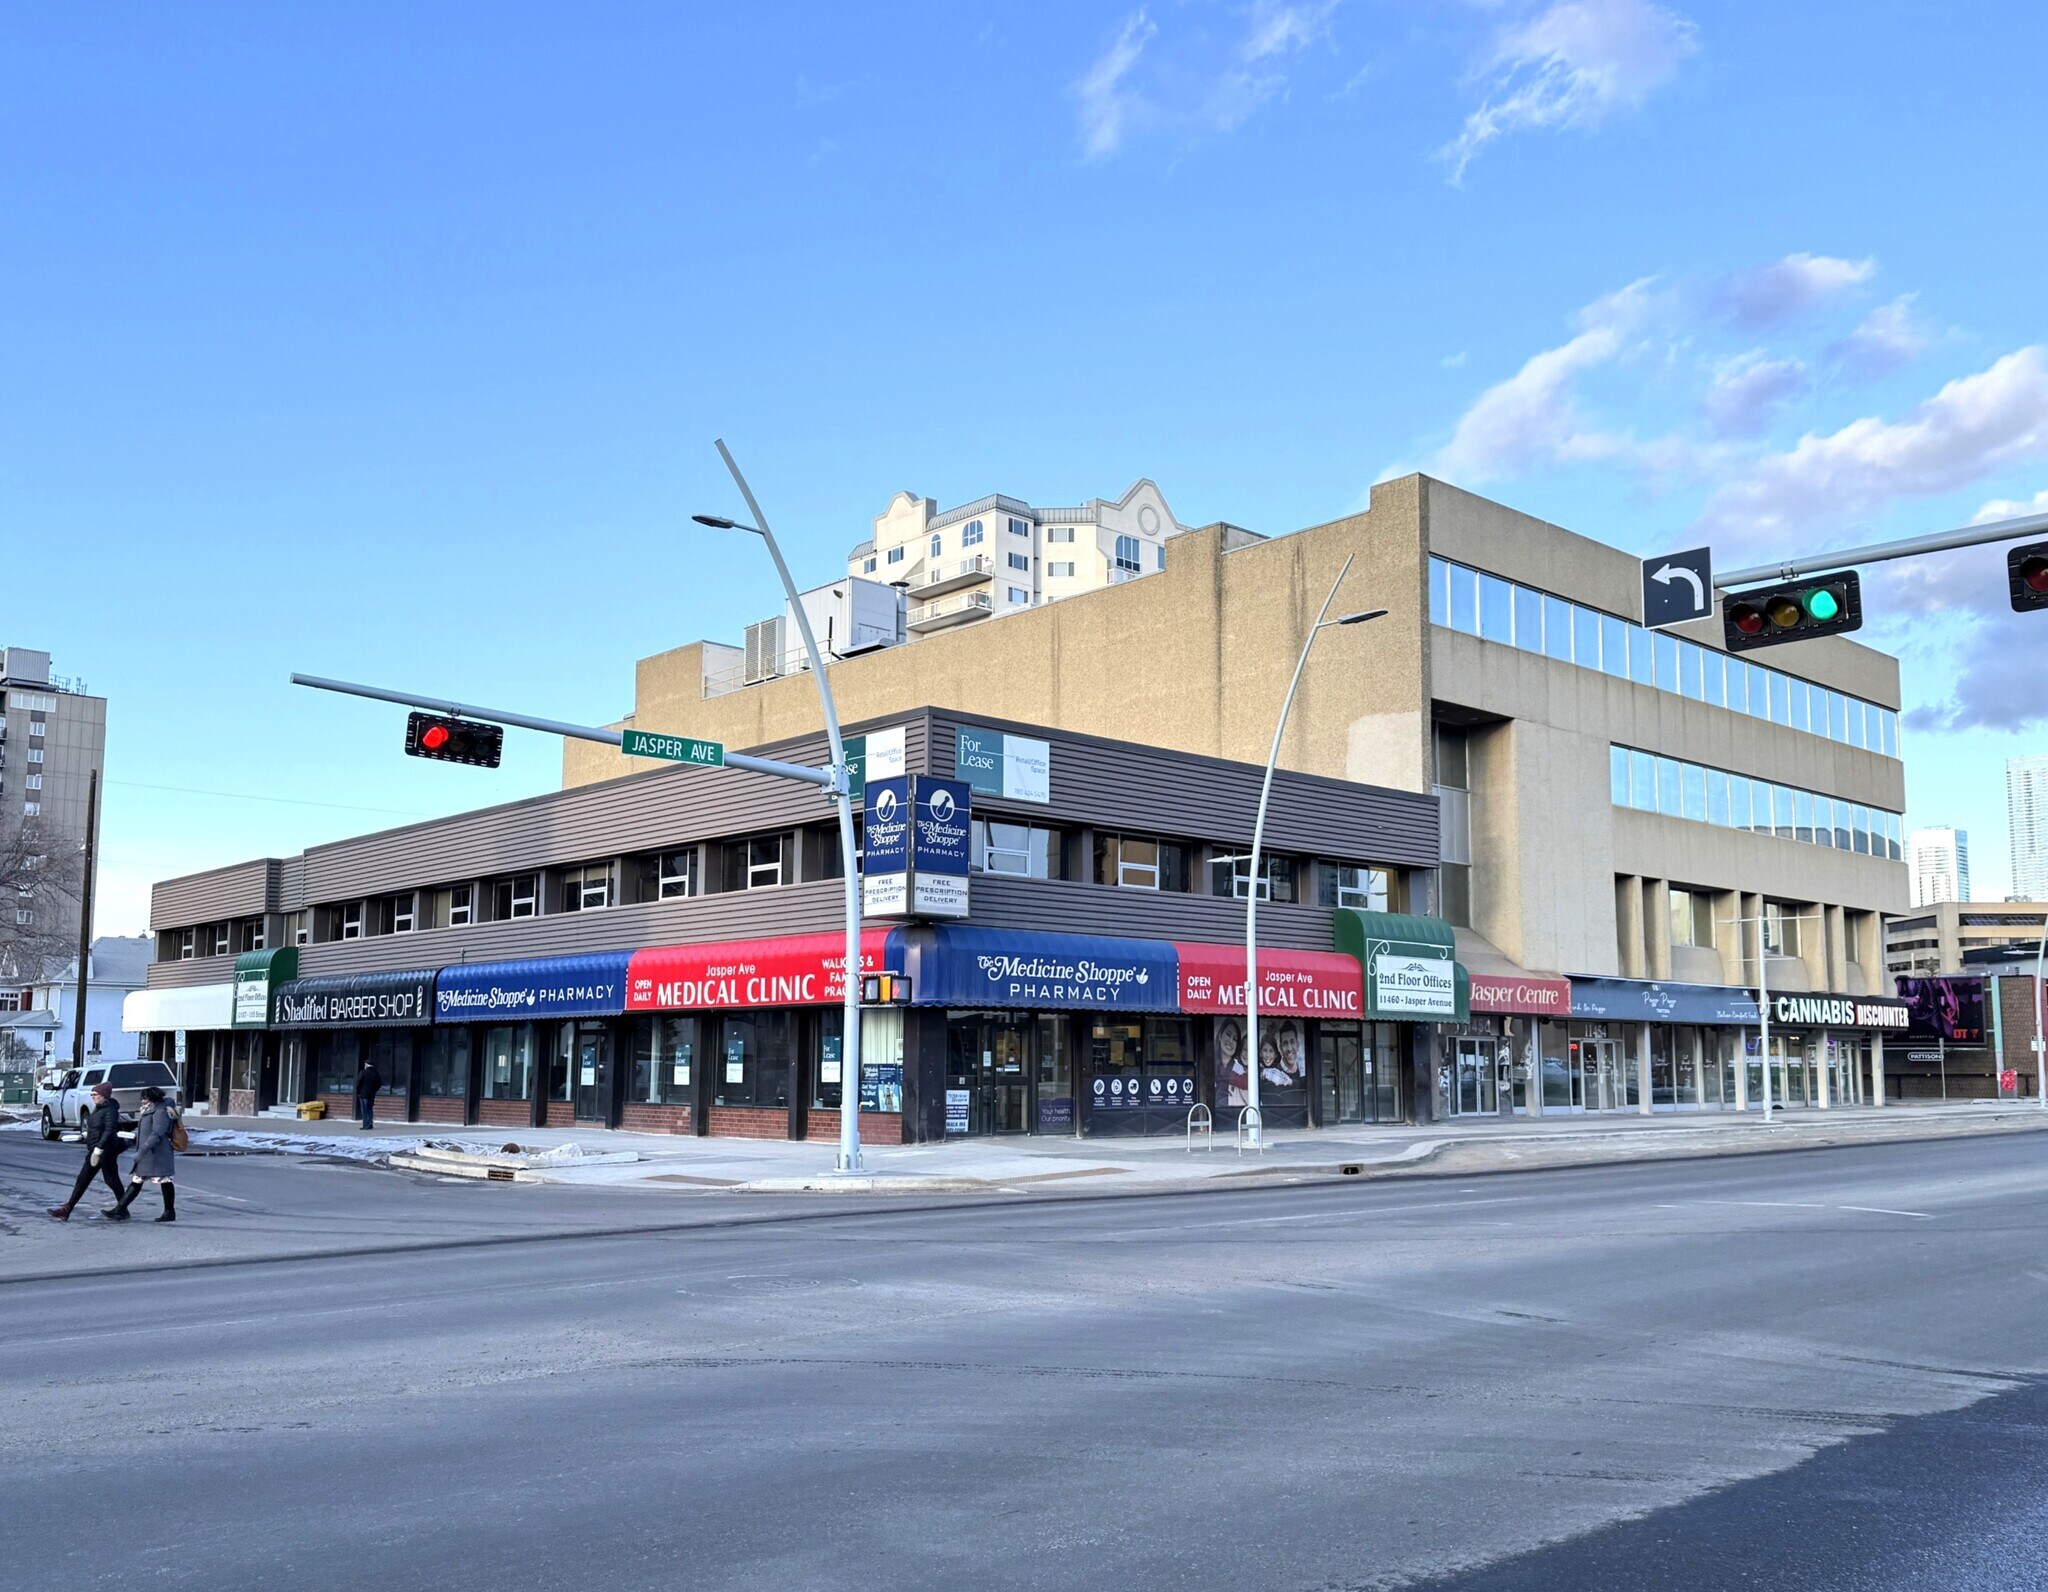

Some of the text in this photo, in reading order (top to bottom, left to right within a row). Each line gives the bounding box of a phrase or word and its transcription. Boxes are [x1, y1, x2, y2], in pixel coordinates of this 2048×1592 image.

[632, 736, 714, 761] JASPER AVE
[960, 735, 981, 752] For
[960, 750, 994, 770] Lease
[1015, 756, 1046, 768] Retail/Office
[1030, 766, 1046, 774] Space
[1014, 787, 1024, 795] 780
[870, 822, 906, 839] Medicine
[917, 820, 967, 837] The Medicine
[873, 833, 901, 847] Shoppe
[926, 832, 960, 847] Shoppe
[867, 847, 905, 858] PHARMACY
[917, 846, 965, 858] PHARMACY
[932, 879, 951, 887] FREE
[865, 886, 906, 895] PRESCRIPTION
[915, 886, 968, 896] PRESCRIPTION
[872, 895, 899, 903] DELIVERY
[924, 895, 958, 904] DELIVERY
[866, 955, 874, 967] &
[705, 963, 756, 978] Jasper Ave
[977, 955, 1135, 985] The Medicine Shoppe
[634, 979, 652, 990] OPEN
[1187, 976, 1211, 988] OPEN
[1265, 970, 1313, 985] Jasper Ave
[1379, 973, 1452, 989] 2nd Floor Offices
[633, 991, 652, 1002] DAILY
[656, 979, 740, 1007] MEDICAL
[746, 973, 816, 1003] CLINIC
[1010, 983, 1120, 1001] PHARMACY
[1187, 988, 1212, 1000] DAILY
[1470, 983, 1559, 1006] Jasper Centre
[441, 988, 489, 1012] Medicine
[488, 987, 527, 1009] Shoppe
[539, 984, 614, 1003] PHARMACY
[1217, 984, 1358, 1011] MEICAL CLINIC
[1379, 995, 1400, 1005] 11460
[1405, 996, 1426, 1006] Jasper
[1427, 998, 1452, 1008] Avenue
[282, 993, 414, 1022] Shadified BARBER SHOP
[1777, 996, 1910, 1028] CANNABIS DISCOUNTER
[1585, 1024, 1608, 1038] 11454
[1041, 1107, 1053, 1115] Your
